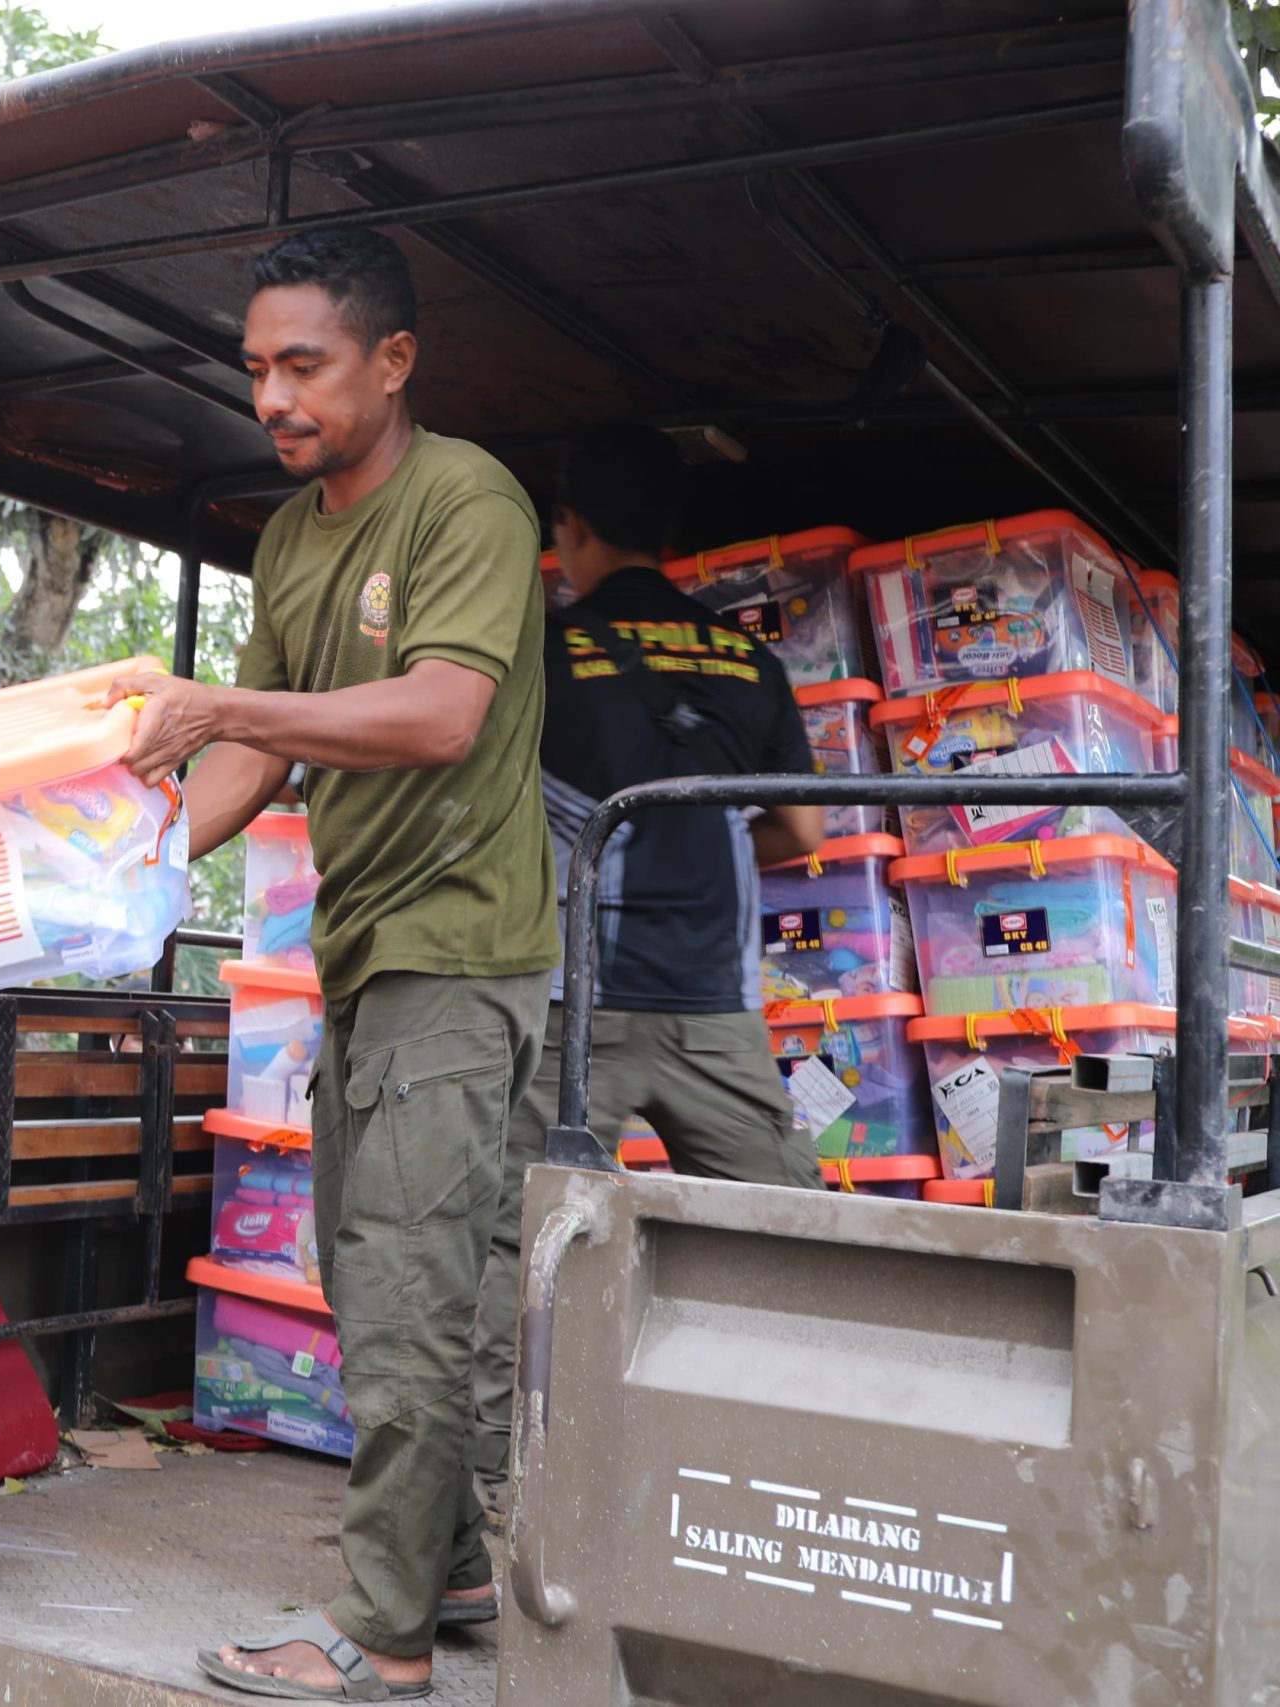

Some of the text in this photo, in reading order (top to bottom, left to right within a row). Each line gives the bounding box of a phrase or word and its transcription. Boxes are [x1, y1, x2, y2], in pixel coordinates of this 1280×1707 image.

[242, 1212, 272, 1228] Jolly
[775, 1502, 922, 1553] DILARANG
[684, 1524, 995, 1606] SALING MENDAHULUI
